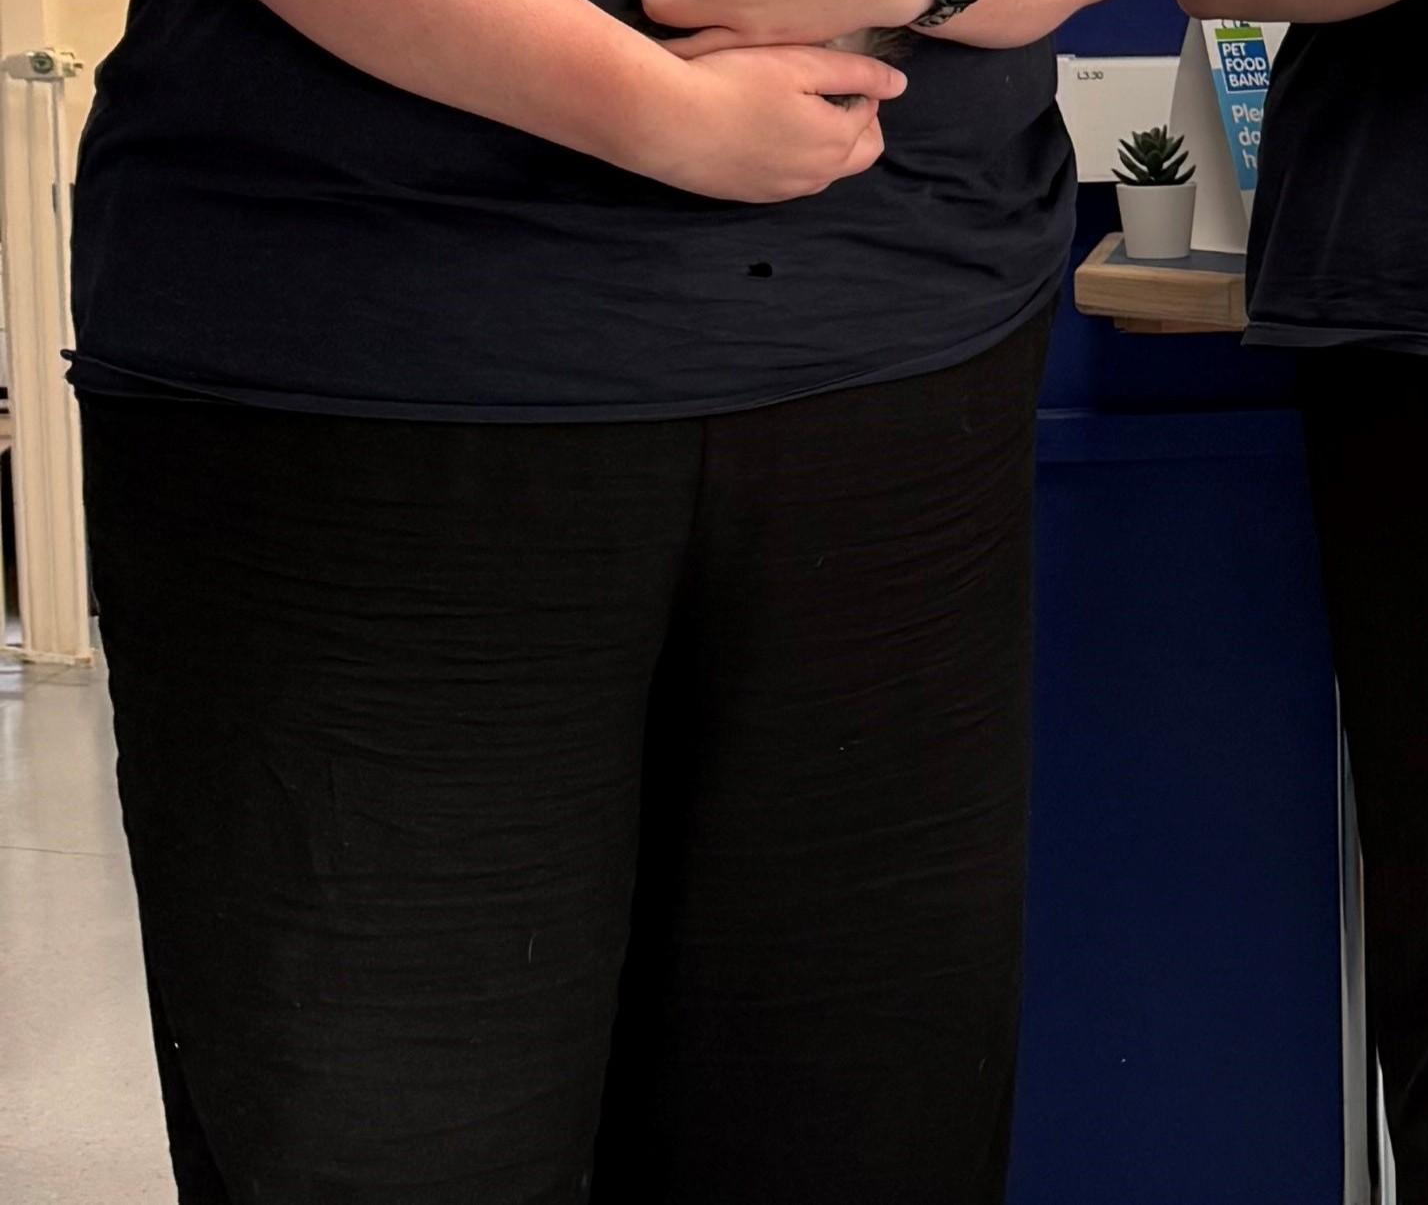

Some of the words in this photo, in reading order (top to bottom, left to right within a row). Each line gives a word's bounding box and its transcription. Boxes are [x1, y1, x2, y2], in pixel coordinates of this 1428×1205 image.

[1222, 42, 1247, 57] PET
[1225, 58, 1267, 72] FOOD
[1229, 73, 1270, 87] BANK
[1232, 105, 1264, 123] Ple
